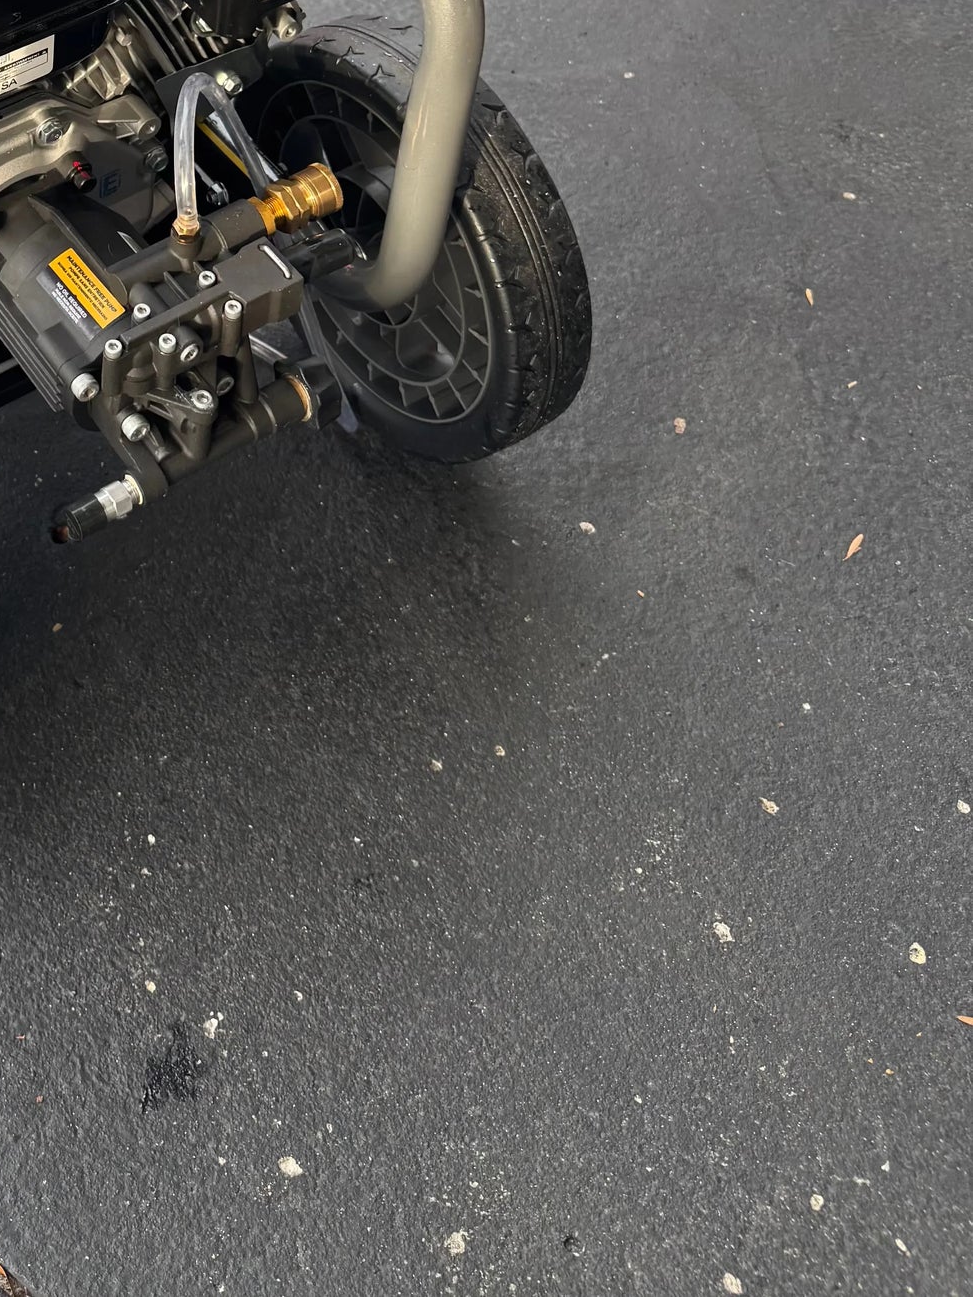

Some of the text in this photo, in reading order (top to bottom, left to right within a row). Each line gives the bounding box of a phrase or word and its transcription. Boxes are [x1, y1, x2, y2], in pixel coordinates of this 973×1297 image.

[65, 255, 96, 288] MAINTENANCE
[93, 286, 107, 301] FREE
[55, 281, 88, 318] NO OIL REQUIRED
